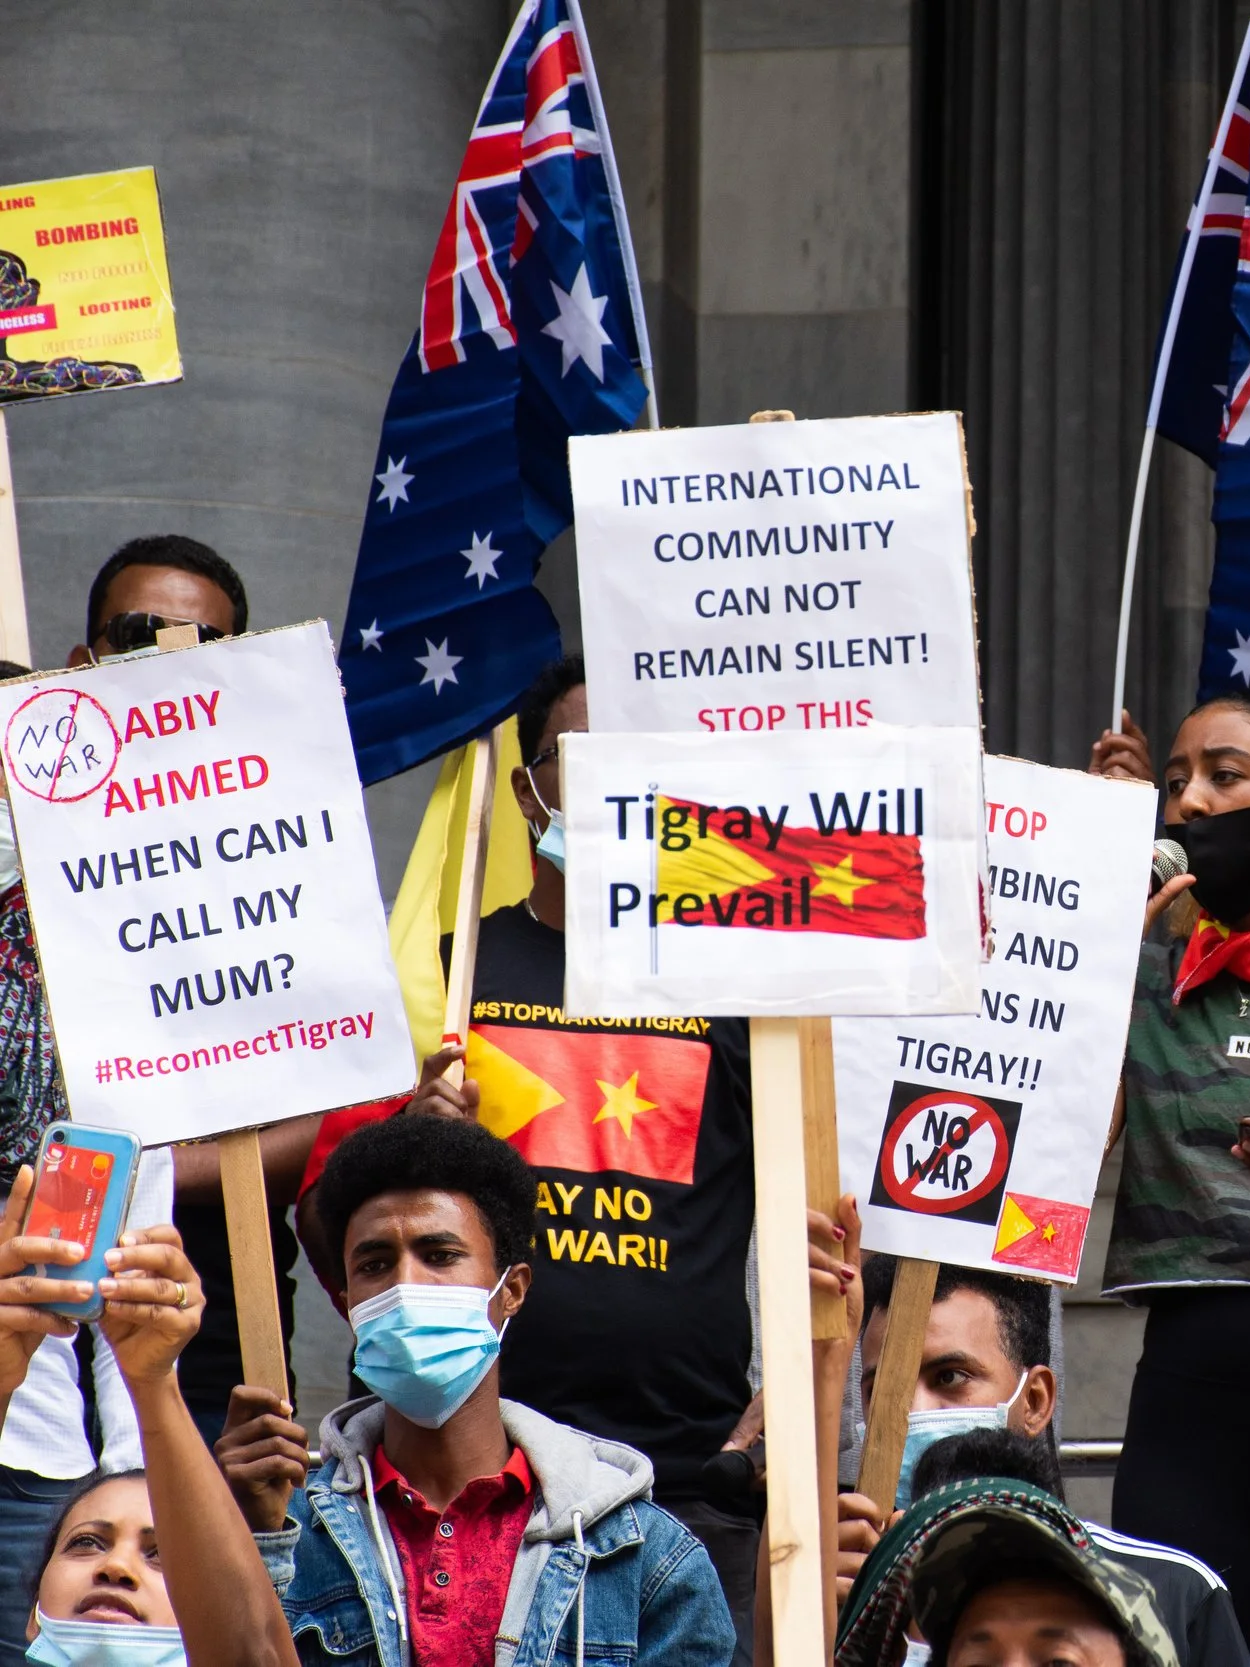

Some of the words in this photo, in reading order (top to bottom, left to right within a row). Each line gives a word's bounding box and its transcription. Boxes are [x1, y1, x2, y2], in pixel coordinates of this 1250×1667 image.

[35, 217, 139, 247] BOMBING
[79, 296, 152, 317] LOOTING
[622, 463, 920, 507] INTERNATIONAL
[654, 520, 894, 563] COMMUNITY
[695, 586, 771, 619] CAN
[784, 580, 862, 613] NOT
[634, 643, 782, 681] REMAIN
[795, 632, 928, 671] SILENT!
[18, 716, 77, 755] NO
[125, 689, 220, 744] ABIY
[697, 704, 787, 732] STOP
[796, 698, 873, 730] THIS
[25, 744, 101, 779] WAR
[103, 753, 270, 818] AHMED
[605, 791, 790, 853] Tigray
[808, 788, 923, 837] Will
[987, 802, 1048, 840] TOP
[60, 835, 202, 893] WHEN
[215, 814, 308, 863] CAN
[321, 809, 334, 843] I
[118, 903, 223, 953] CALL
[233, 883, 302, 930] MY
[609, 877, 812, 928] Prevail
[1004, 932, 1079, 972] AND
[149, 953, 295, 1018] MUM?
[1028, 998, 1066, 1033] IN
[96, 1011, 374, 1083] #ReconnectTigray
[896, 1035, 1043, 1092] TIGRAY!!
[922, 1109, 971, 1150] NO
[906, 1143, 973, 1191] WAR
[536, 1182, 583, 1216] AY
[594, 1186, 652, 1222] NO
[546, 1228, 668, 1272] WAR!!
